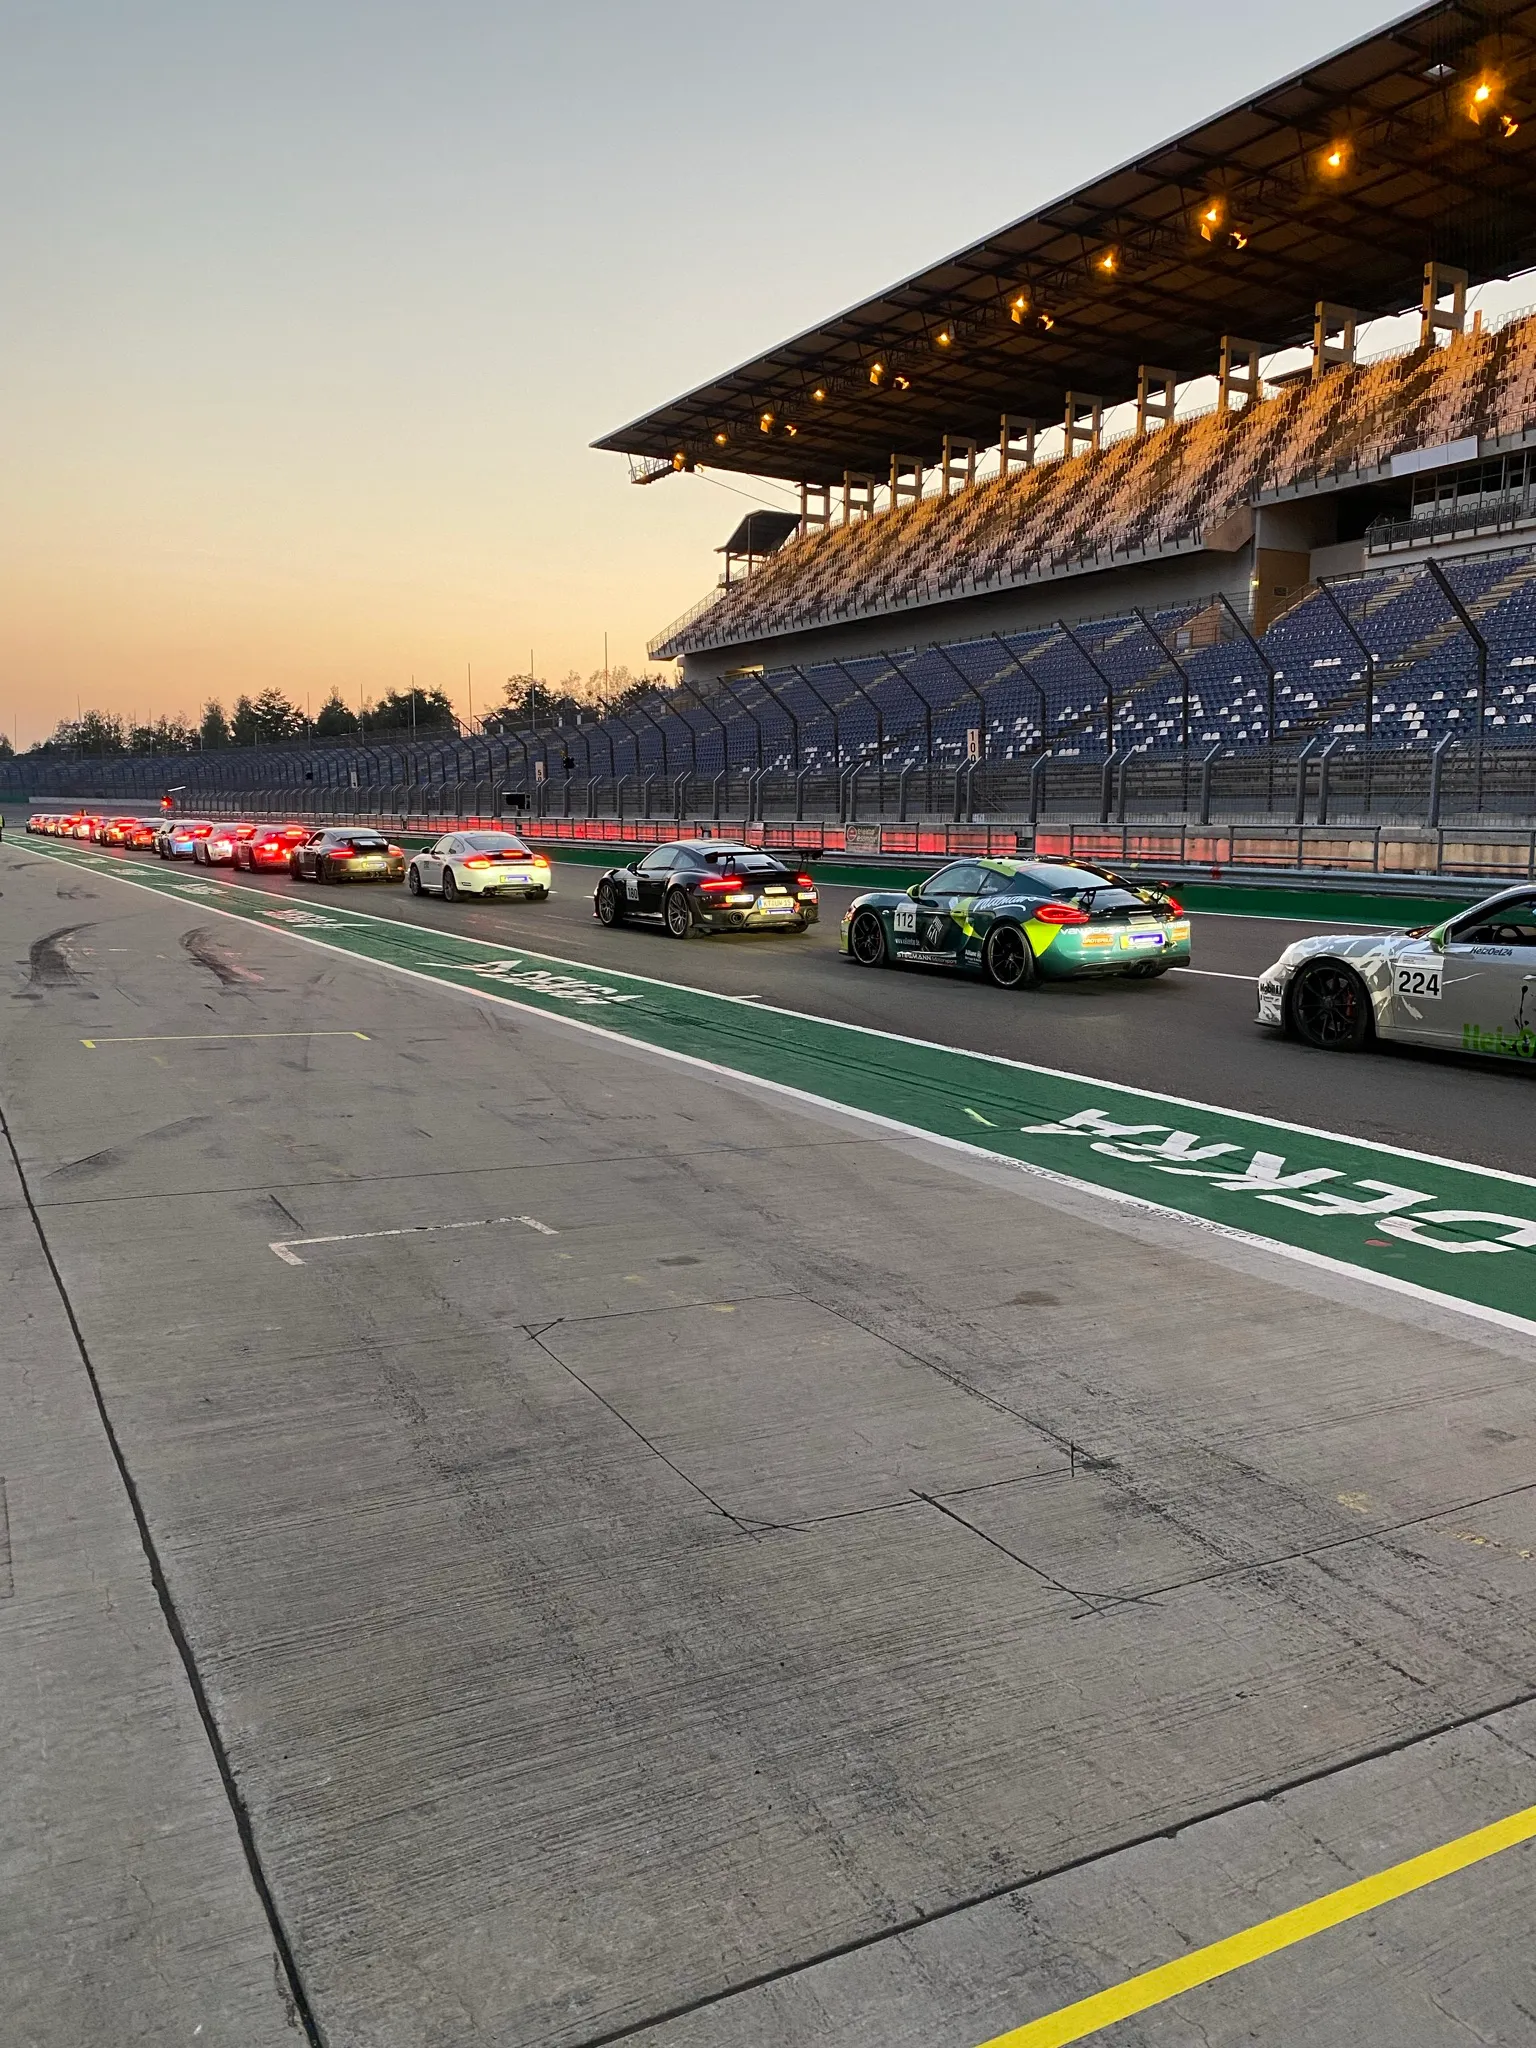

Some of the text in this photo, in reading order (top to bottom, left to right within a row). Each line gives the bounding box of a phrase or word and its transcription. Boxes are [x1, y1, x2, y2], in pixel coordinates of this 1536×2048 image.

[896, 913, 914, 929] 112
[1470, 946, 1513, 957] HeizOel24
[1398, 971, 1440, 996] 224
[1020, 1108, 1536, 1253] DEKRA
